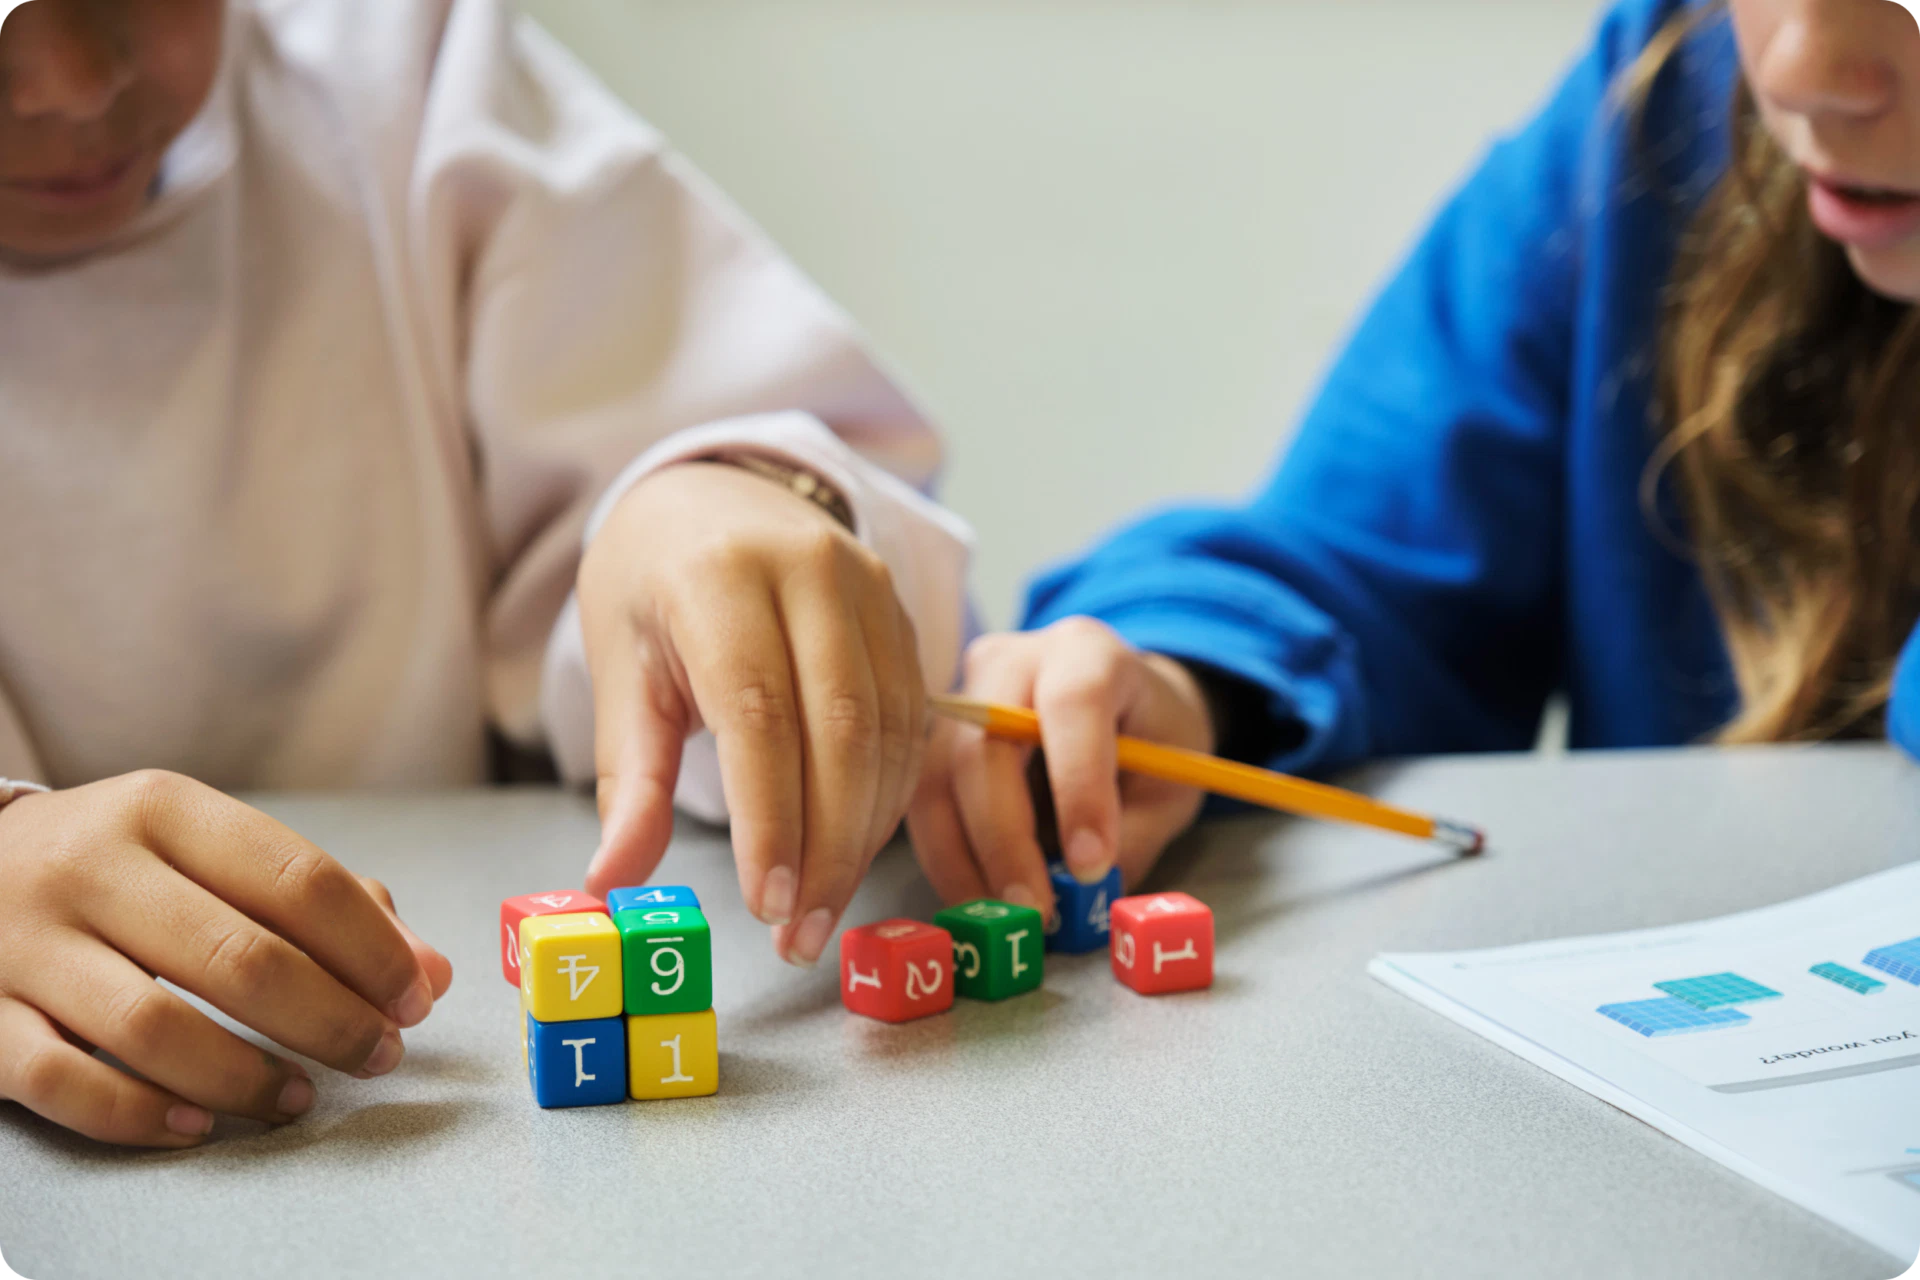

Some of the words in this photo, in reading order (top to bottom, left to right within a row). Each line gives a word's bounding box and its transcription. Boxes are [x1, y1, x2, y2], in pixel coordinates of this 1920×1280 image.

[1006, 928, 1029, 979] 1
[1153, 938, 1199, 975] 1
[557, 954, 600, 1002] 4
[848, 960, 882, 993] 1
[905, 959, 943, 1001] 2
[1759, 1041, 1867, 1064] wonder?
[1869, 1030, 1918, 1044] you
[562, 1037, 597, 1088] 1
[661, 1034, 695, 1084] 1
